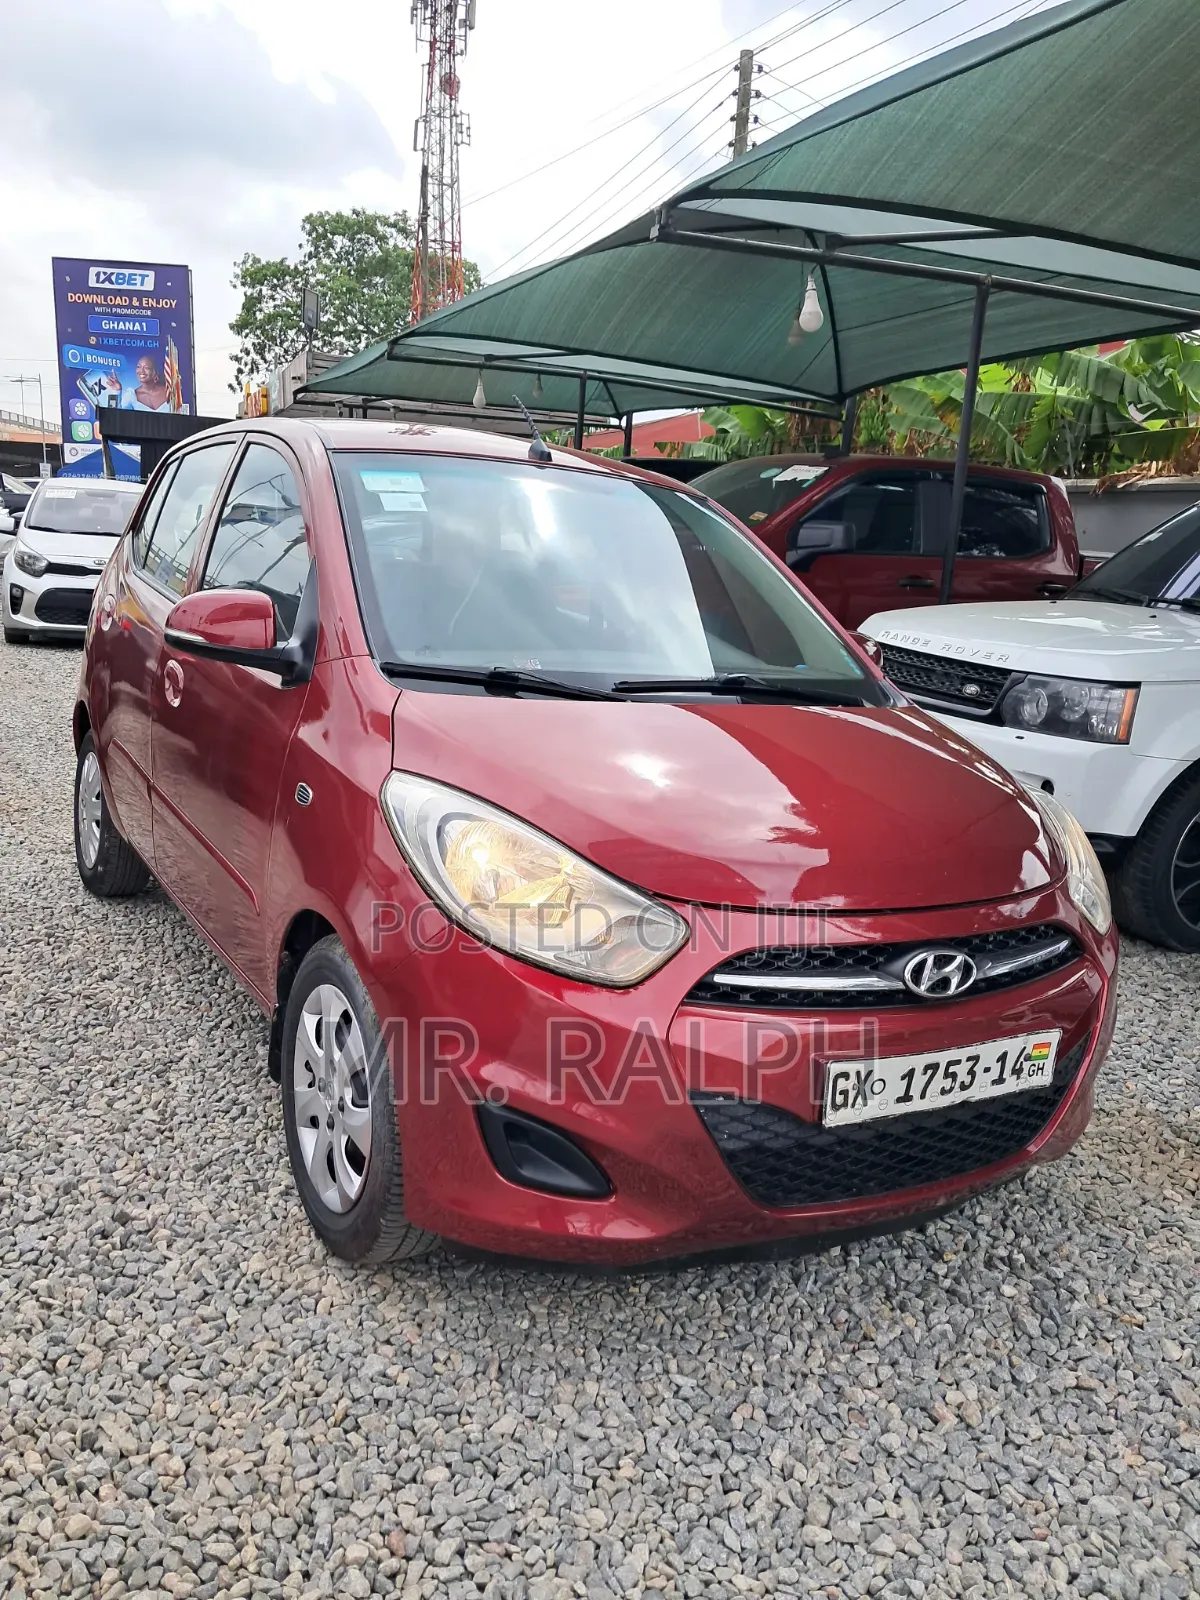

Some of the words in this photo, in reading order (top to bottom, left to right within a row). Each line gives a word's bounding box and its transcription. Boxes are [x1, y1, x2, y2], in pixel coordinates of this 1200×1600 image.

[95, 271, 150, 287] 1XBET
[67, 293, 129, 306] DOWNLOAD
[132, 297, 140, 306] &
[142, 298, 178, 308] ENJOY
[112, 308, 152, 316] PROMOCODE
[101, 320, 147, 332] GHANA1
[98, 338, 160, 348] 1XBET.COM.GH
[86, 353, 121, 367] BONUSES
[881, 630, 931, 648] RANGE
[940, 642, 1010, 663] ROVER
[895, 1046, 1026, 1103] 1753-14
[1027, 1062, 1045, 1077] GH
